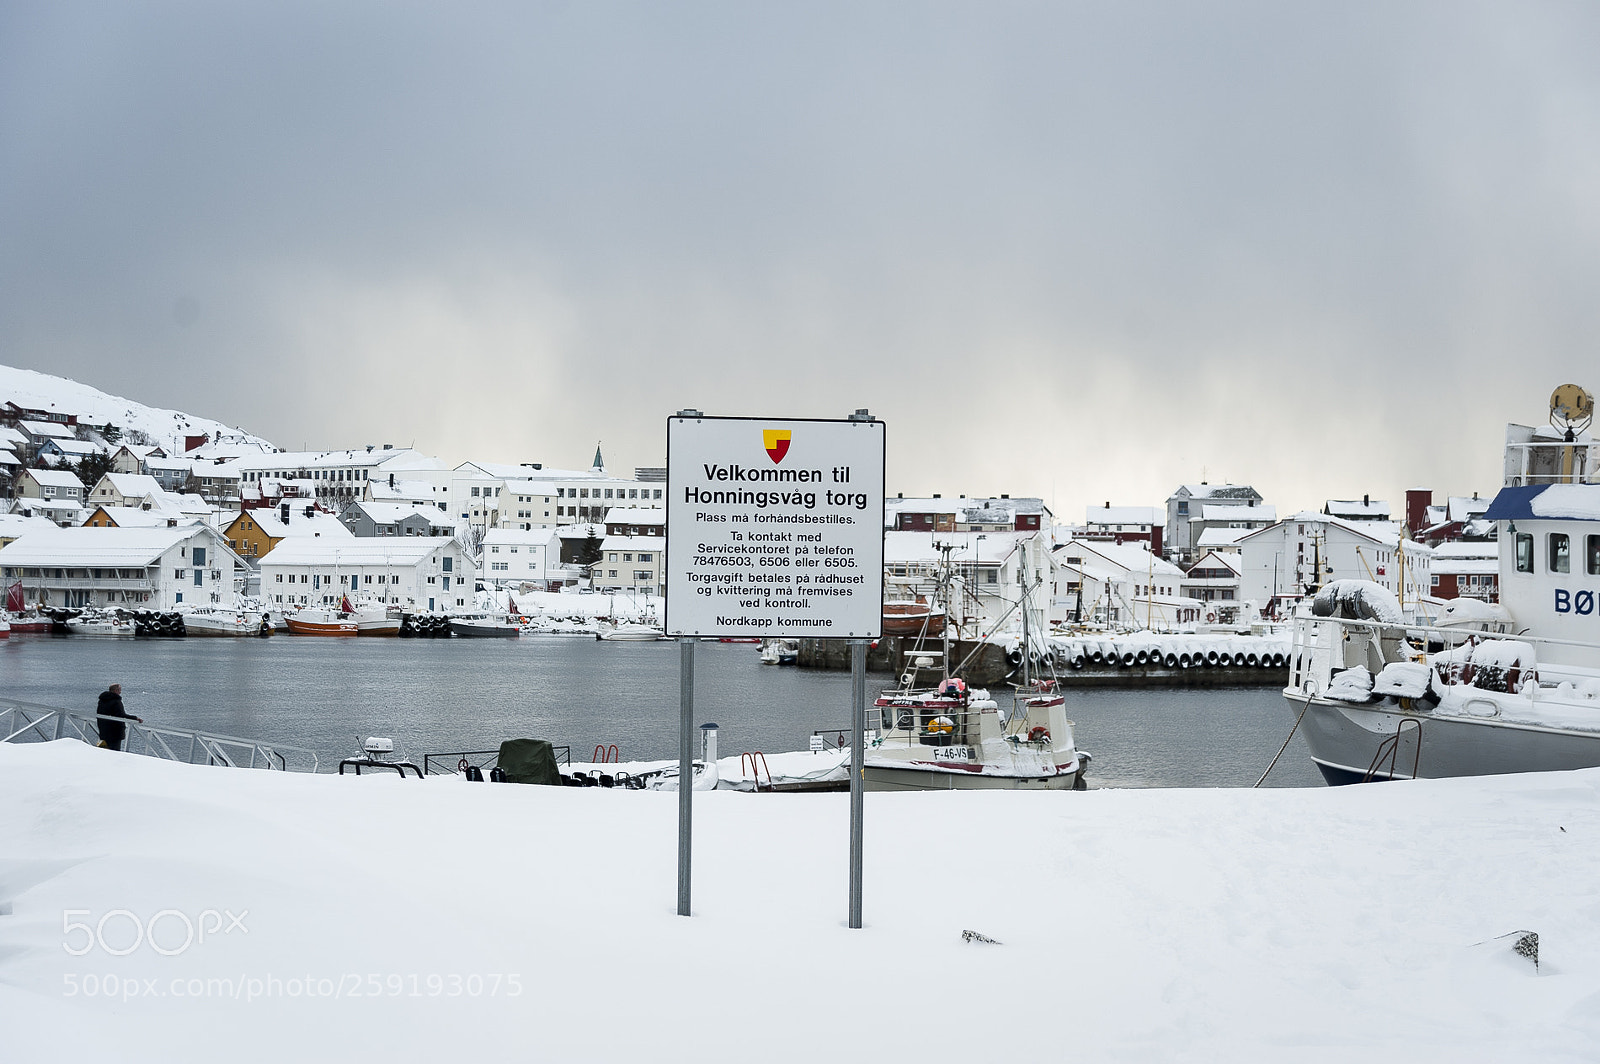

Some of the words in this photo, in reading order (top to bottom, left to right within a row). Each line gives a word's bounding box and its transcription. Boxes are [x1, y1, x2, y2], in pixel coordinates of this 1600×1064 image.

[703, 464, 822, 483] Velkommen
[831, 466, 850, 484] til
[684, 486, 816, 510] Honningsvåg
[825, 489, 868, 511] torg
[695, 512, 727, 523] Plass
[731, 512, 749, 523] må
[753, 512, 856, 525] forhåndsbestilles.
[730, 530, 743, 542] Ta
[748, 531, 793, 542] kontakt
[796, 532, 822, 543] med
[697, 542, 790, 555] Servicekontoret
[794, 544, 809, 557] på
[813, 544, 854, 555] telefon
[692, 555, 755, 569] 78476503,
[759, 556, 791, 567] 6506
[794, 557, 820, 568] eller
[824, 557, 858, 568] 6505.
[685, 571, 744, 585] Torgavgift
[748, 572, 791, 583] betales
[795, 573, 810, 585] på
[814, 573, 865, 584] rådhuset
[696, 587, 712, 597] og
[716, 584, 771, 598] kvittering
[775, 585, 793, 596] må
[797, 585, 853, 597] fremvises
[739, 597, 761, 608] ved
[764, 597, 811, 609] kontroll.
[1554, 588, 1600, 617] BØ
[716, 615, 773, 629] Nordkapp
[777, 616, 833, 627] kommune
[933, 748, 968, 760] F-46-VS
